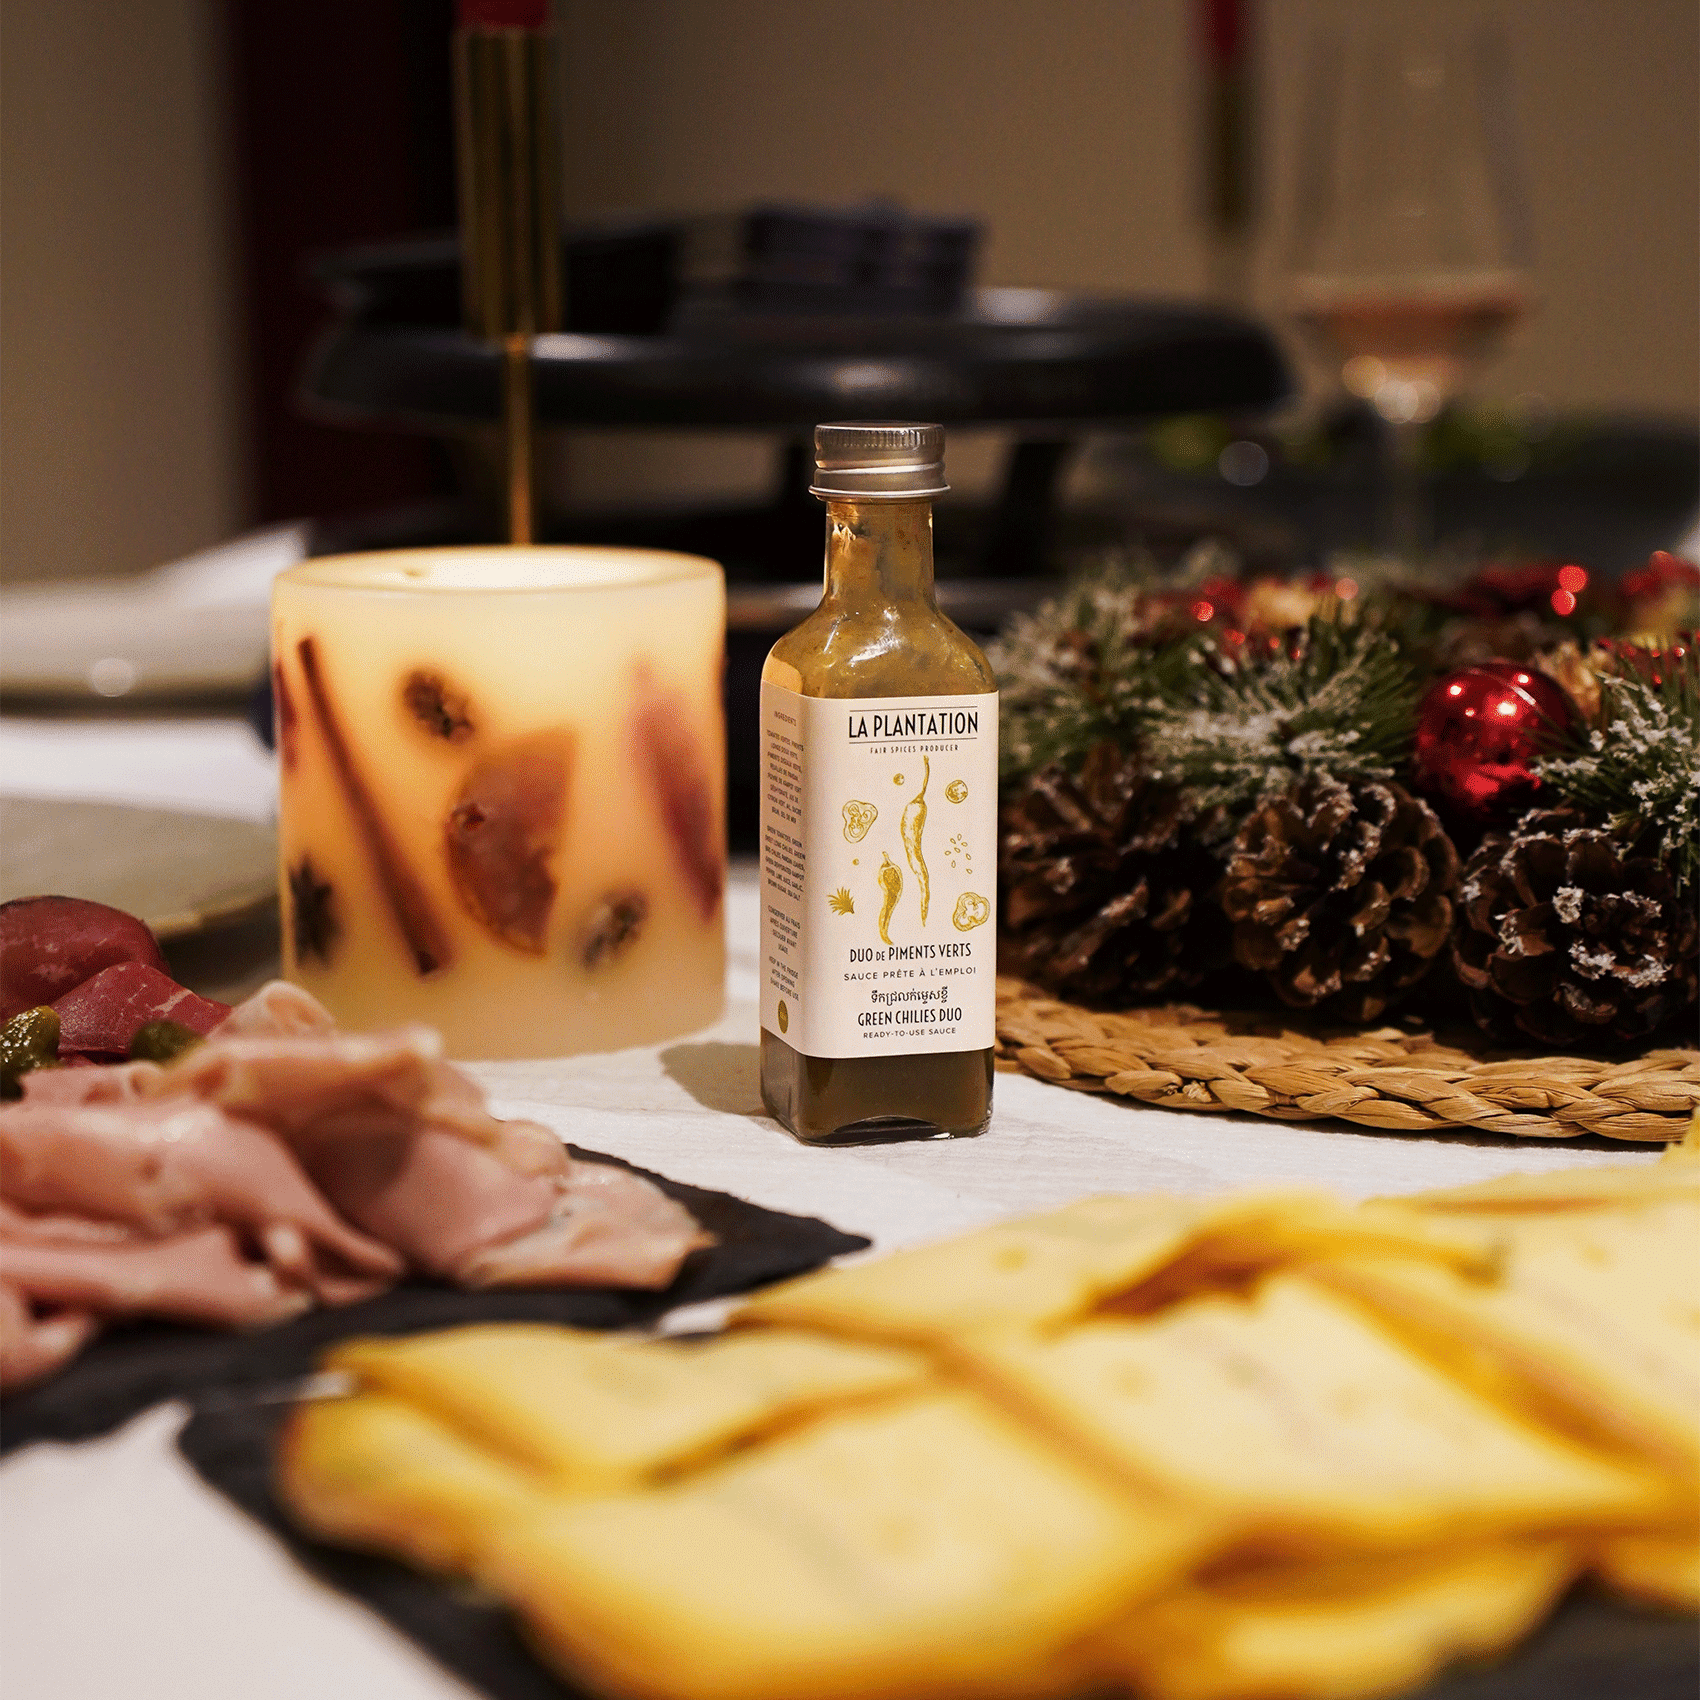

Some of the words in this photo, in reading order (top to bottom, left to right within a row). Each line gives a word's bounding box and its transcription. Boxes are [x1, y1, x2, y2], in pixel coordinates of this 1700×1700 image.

[849, 716, 868, 738] LA
[874, 712, 978, 737] PLANTATION
[890, 746, 916, 754] SPICES
[920, 744, 959, 752] PRODUCER
[850, 948, 873, 963] DUO
[888, 945, 936, 960] PIMENTS
[939, 943, 972, 958] VERTS
[844, 972, 878, 981] SAUCE
[883, 969, 914, 978] PRÊTE
[919, 968, 926, 977] À
[930, 967, 976, 976] L'EMPLOI
[858, 1011, 892, 1026] GREEN
[896, 1008, 936, 1024] CHILIES
[940, 1007, 962, 1022] DUO
[863, 1029, 925, 1038] READY-TO-USE
